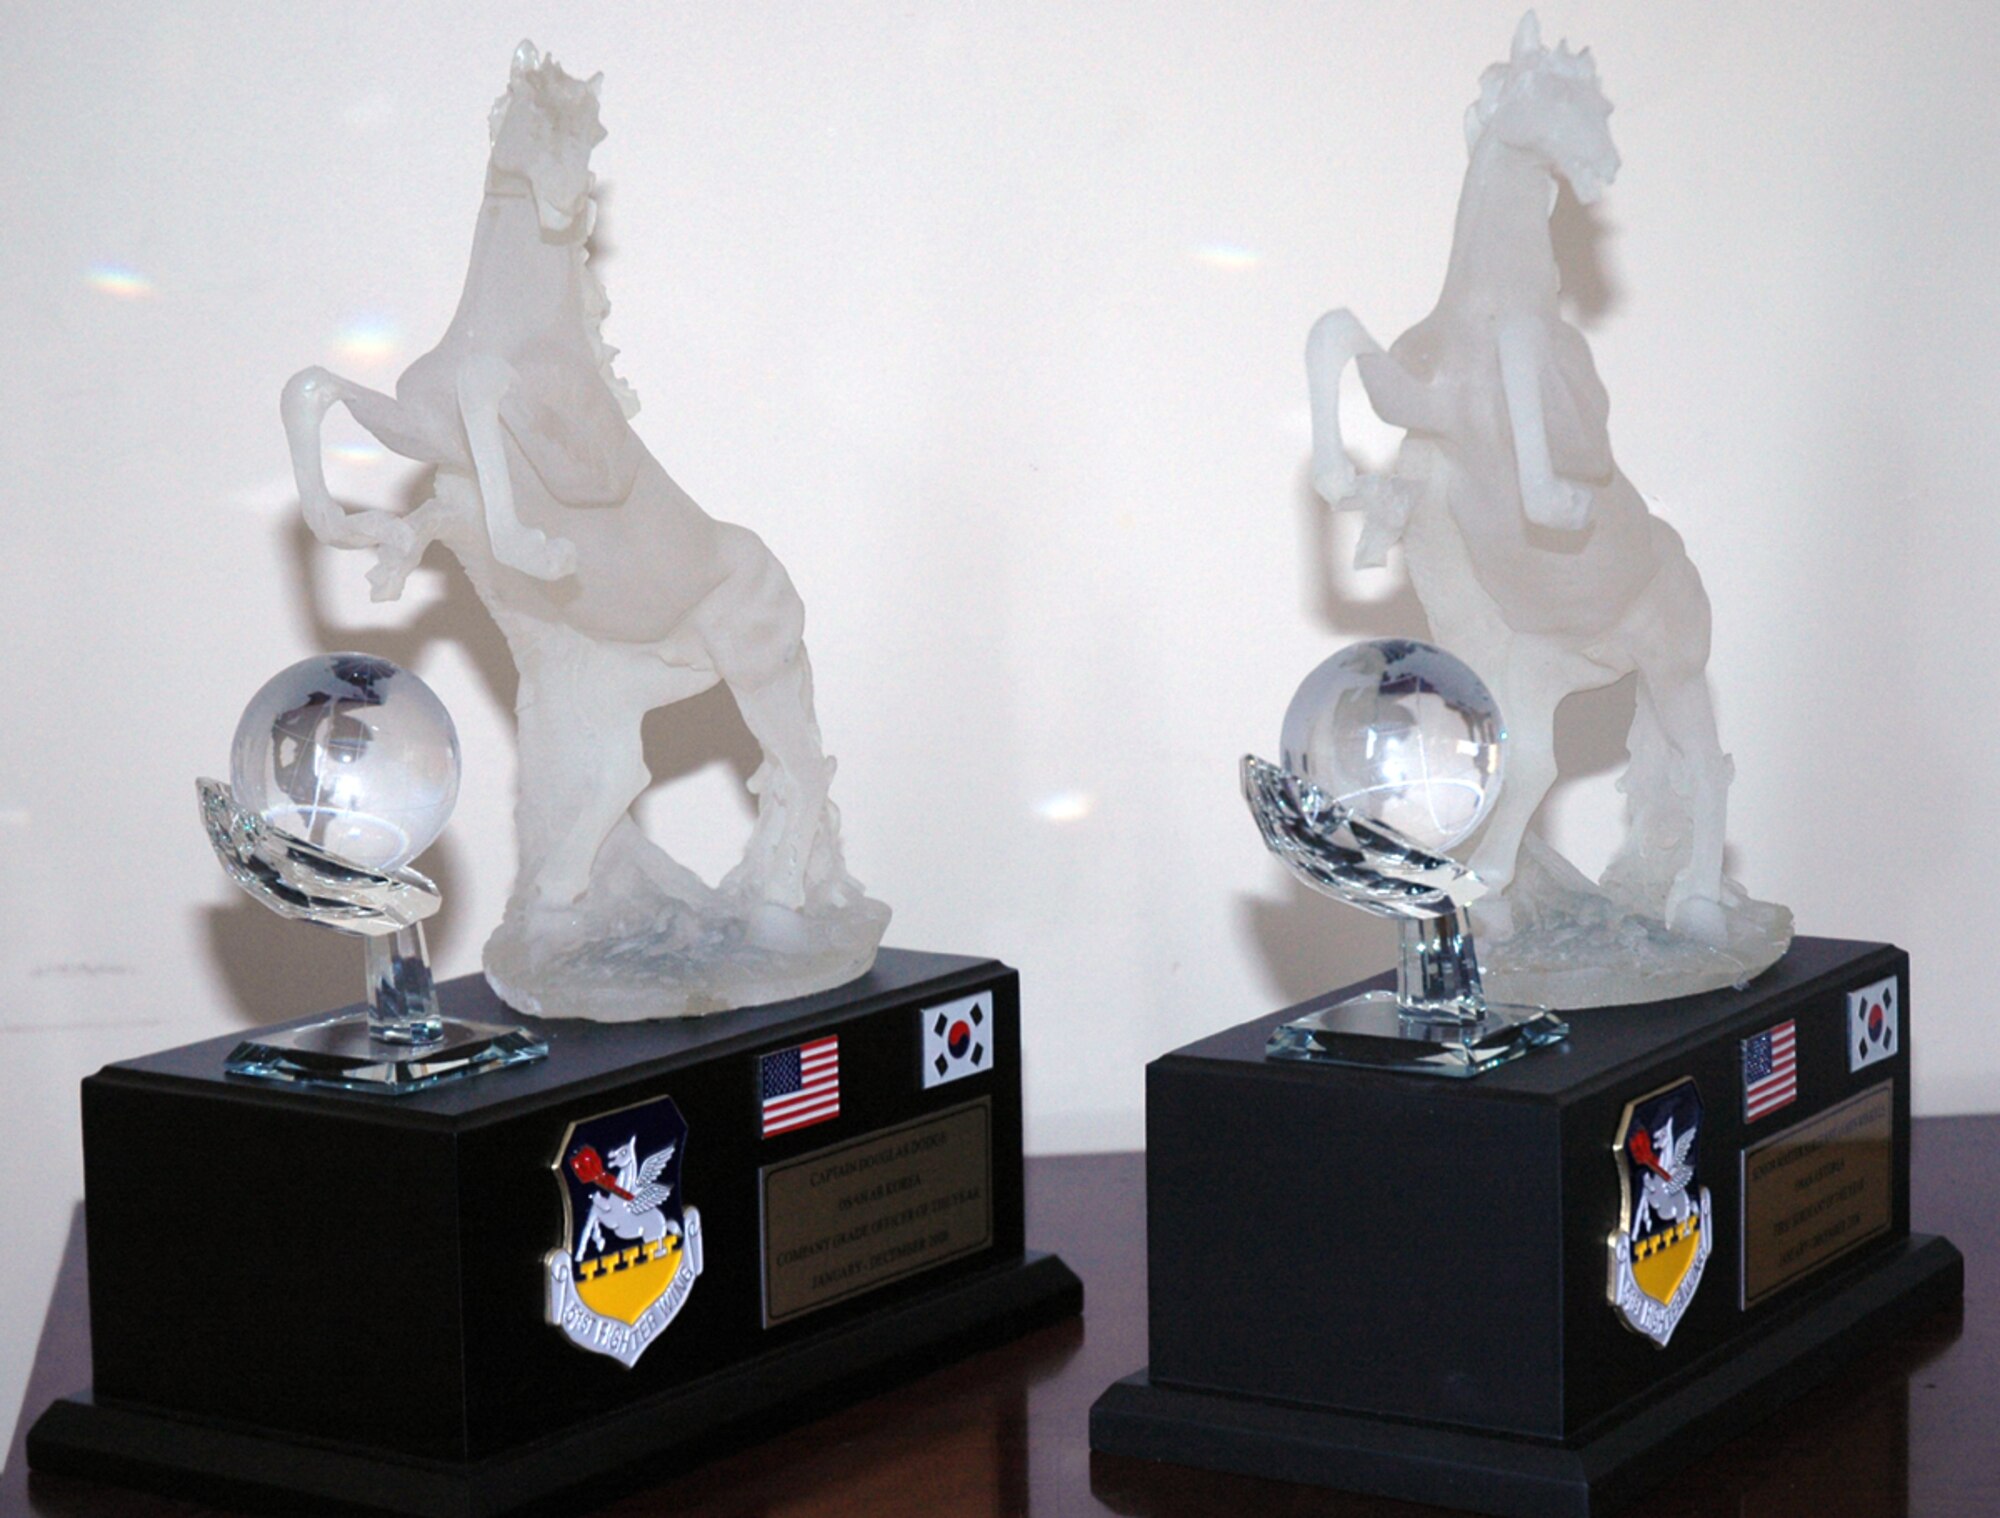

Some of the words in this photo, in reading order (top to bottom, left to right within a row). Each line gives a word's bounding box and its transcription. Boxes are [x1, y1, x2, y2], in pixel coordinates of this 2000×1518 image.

[809, 1160, 857, 1186] CAPTAIN
[776, 1238, 828, 1267] COMPANY
[832, 1225, 867, 1247] GRADE
[870, 1209, 912, 1234] OFFICER
[915, 1204, 928, 1218] OF
[950, 1186, 980, 1206] YEAR
[811, 1260, 862, 1289] JANUARY
[869, 1238, 925, 1268] DECEMBER
[594, 1312, 659, 1354] FIGHTER
[655, 1264, 694, 1317] WING
